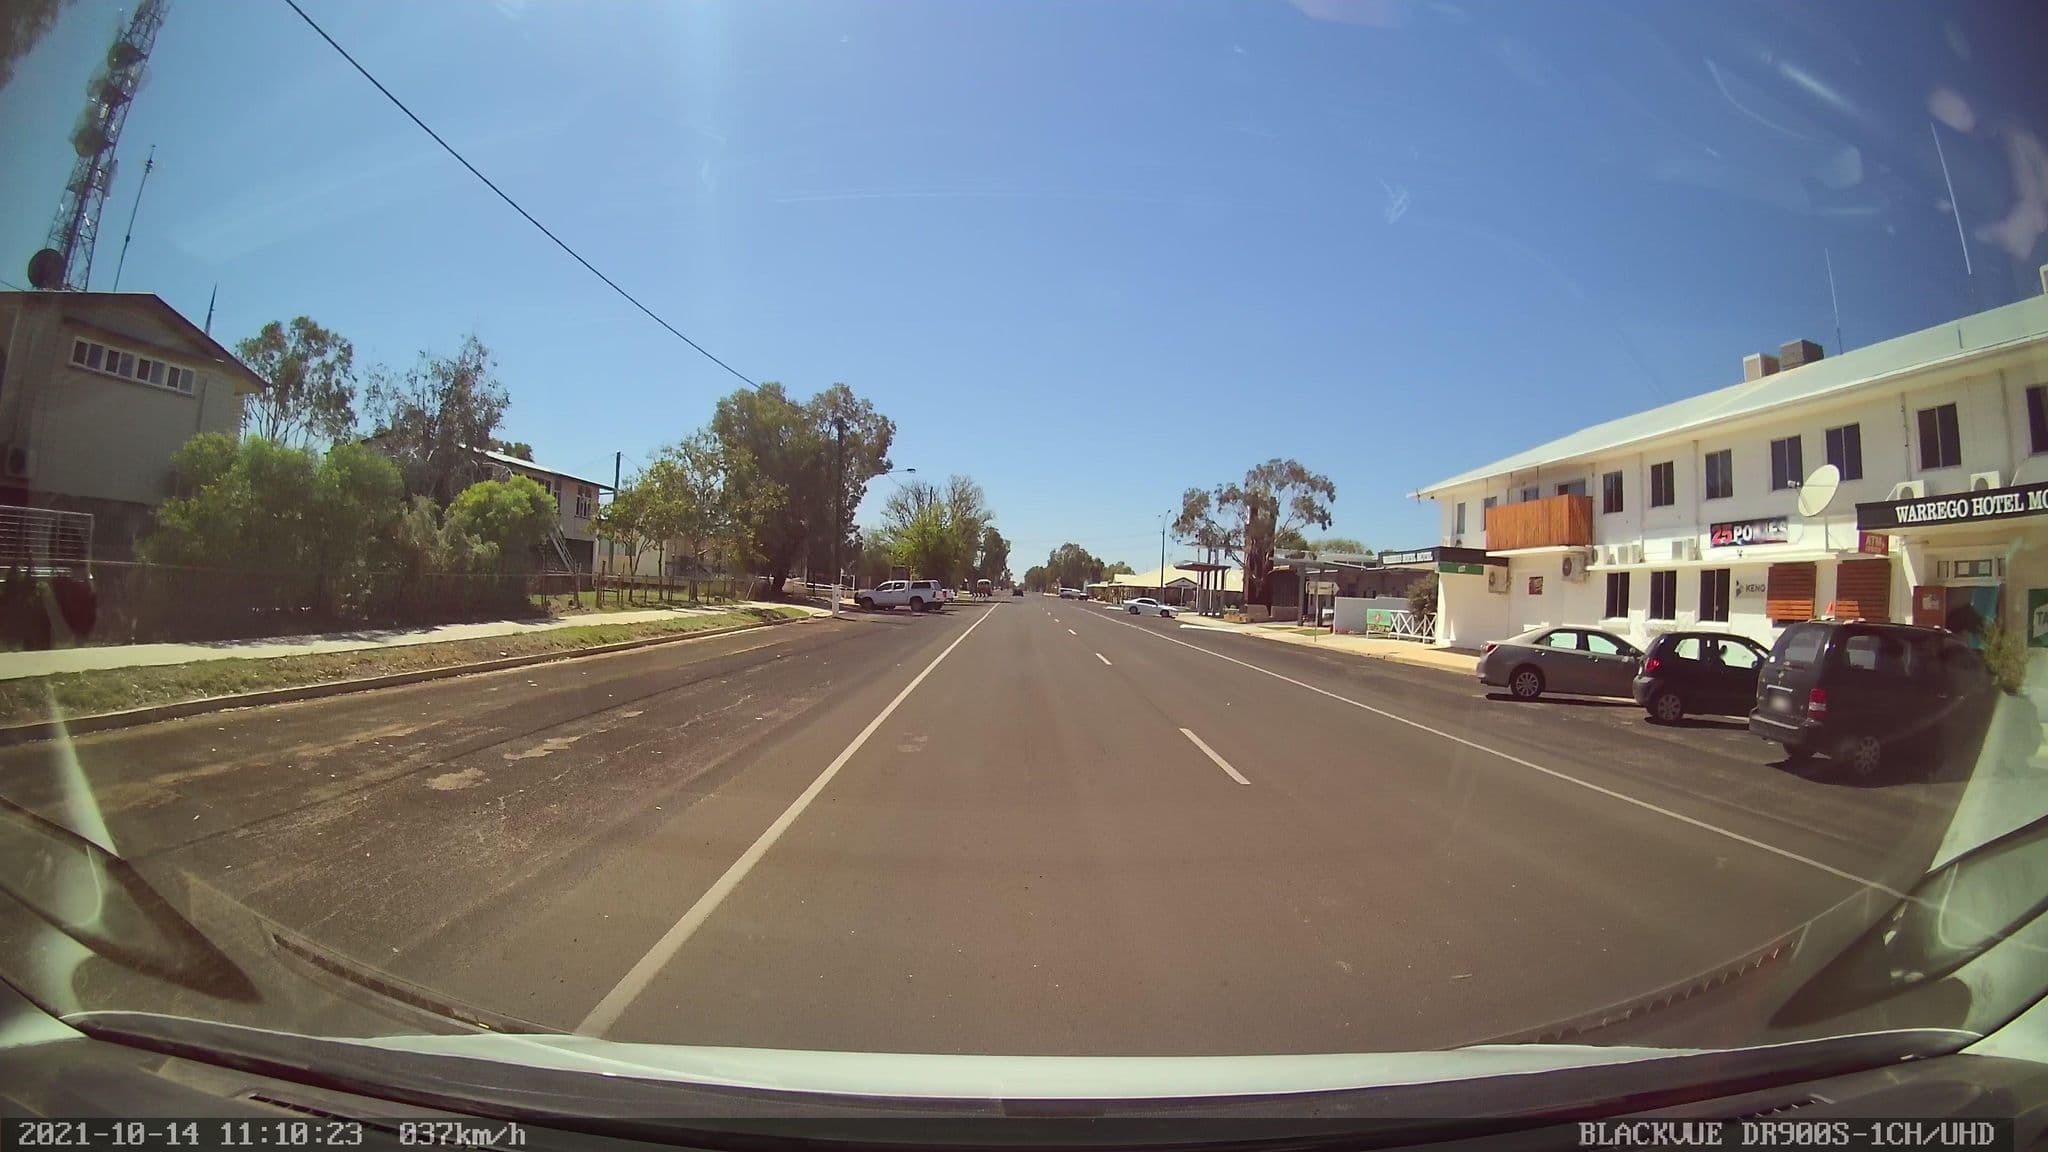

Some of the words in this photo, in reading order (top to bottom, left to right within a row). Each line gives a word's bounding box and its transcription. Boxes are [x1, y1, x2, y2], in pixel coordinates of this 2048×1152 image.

[1895, 499, 1969, 523] WARREGO
[1971, 493, 2025, 517] HOTEL
[2026, 489, 2048, 510] MO
[1711, 525, 1733, 545] 25
[1745, 584, 1766, 592] KENO
